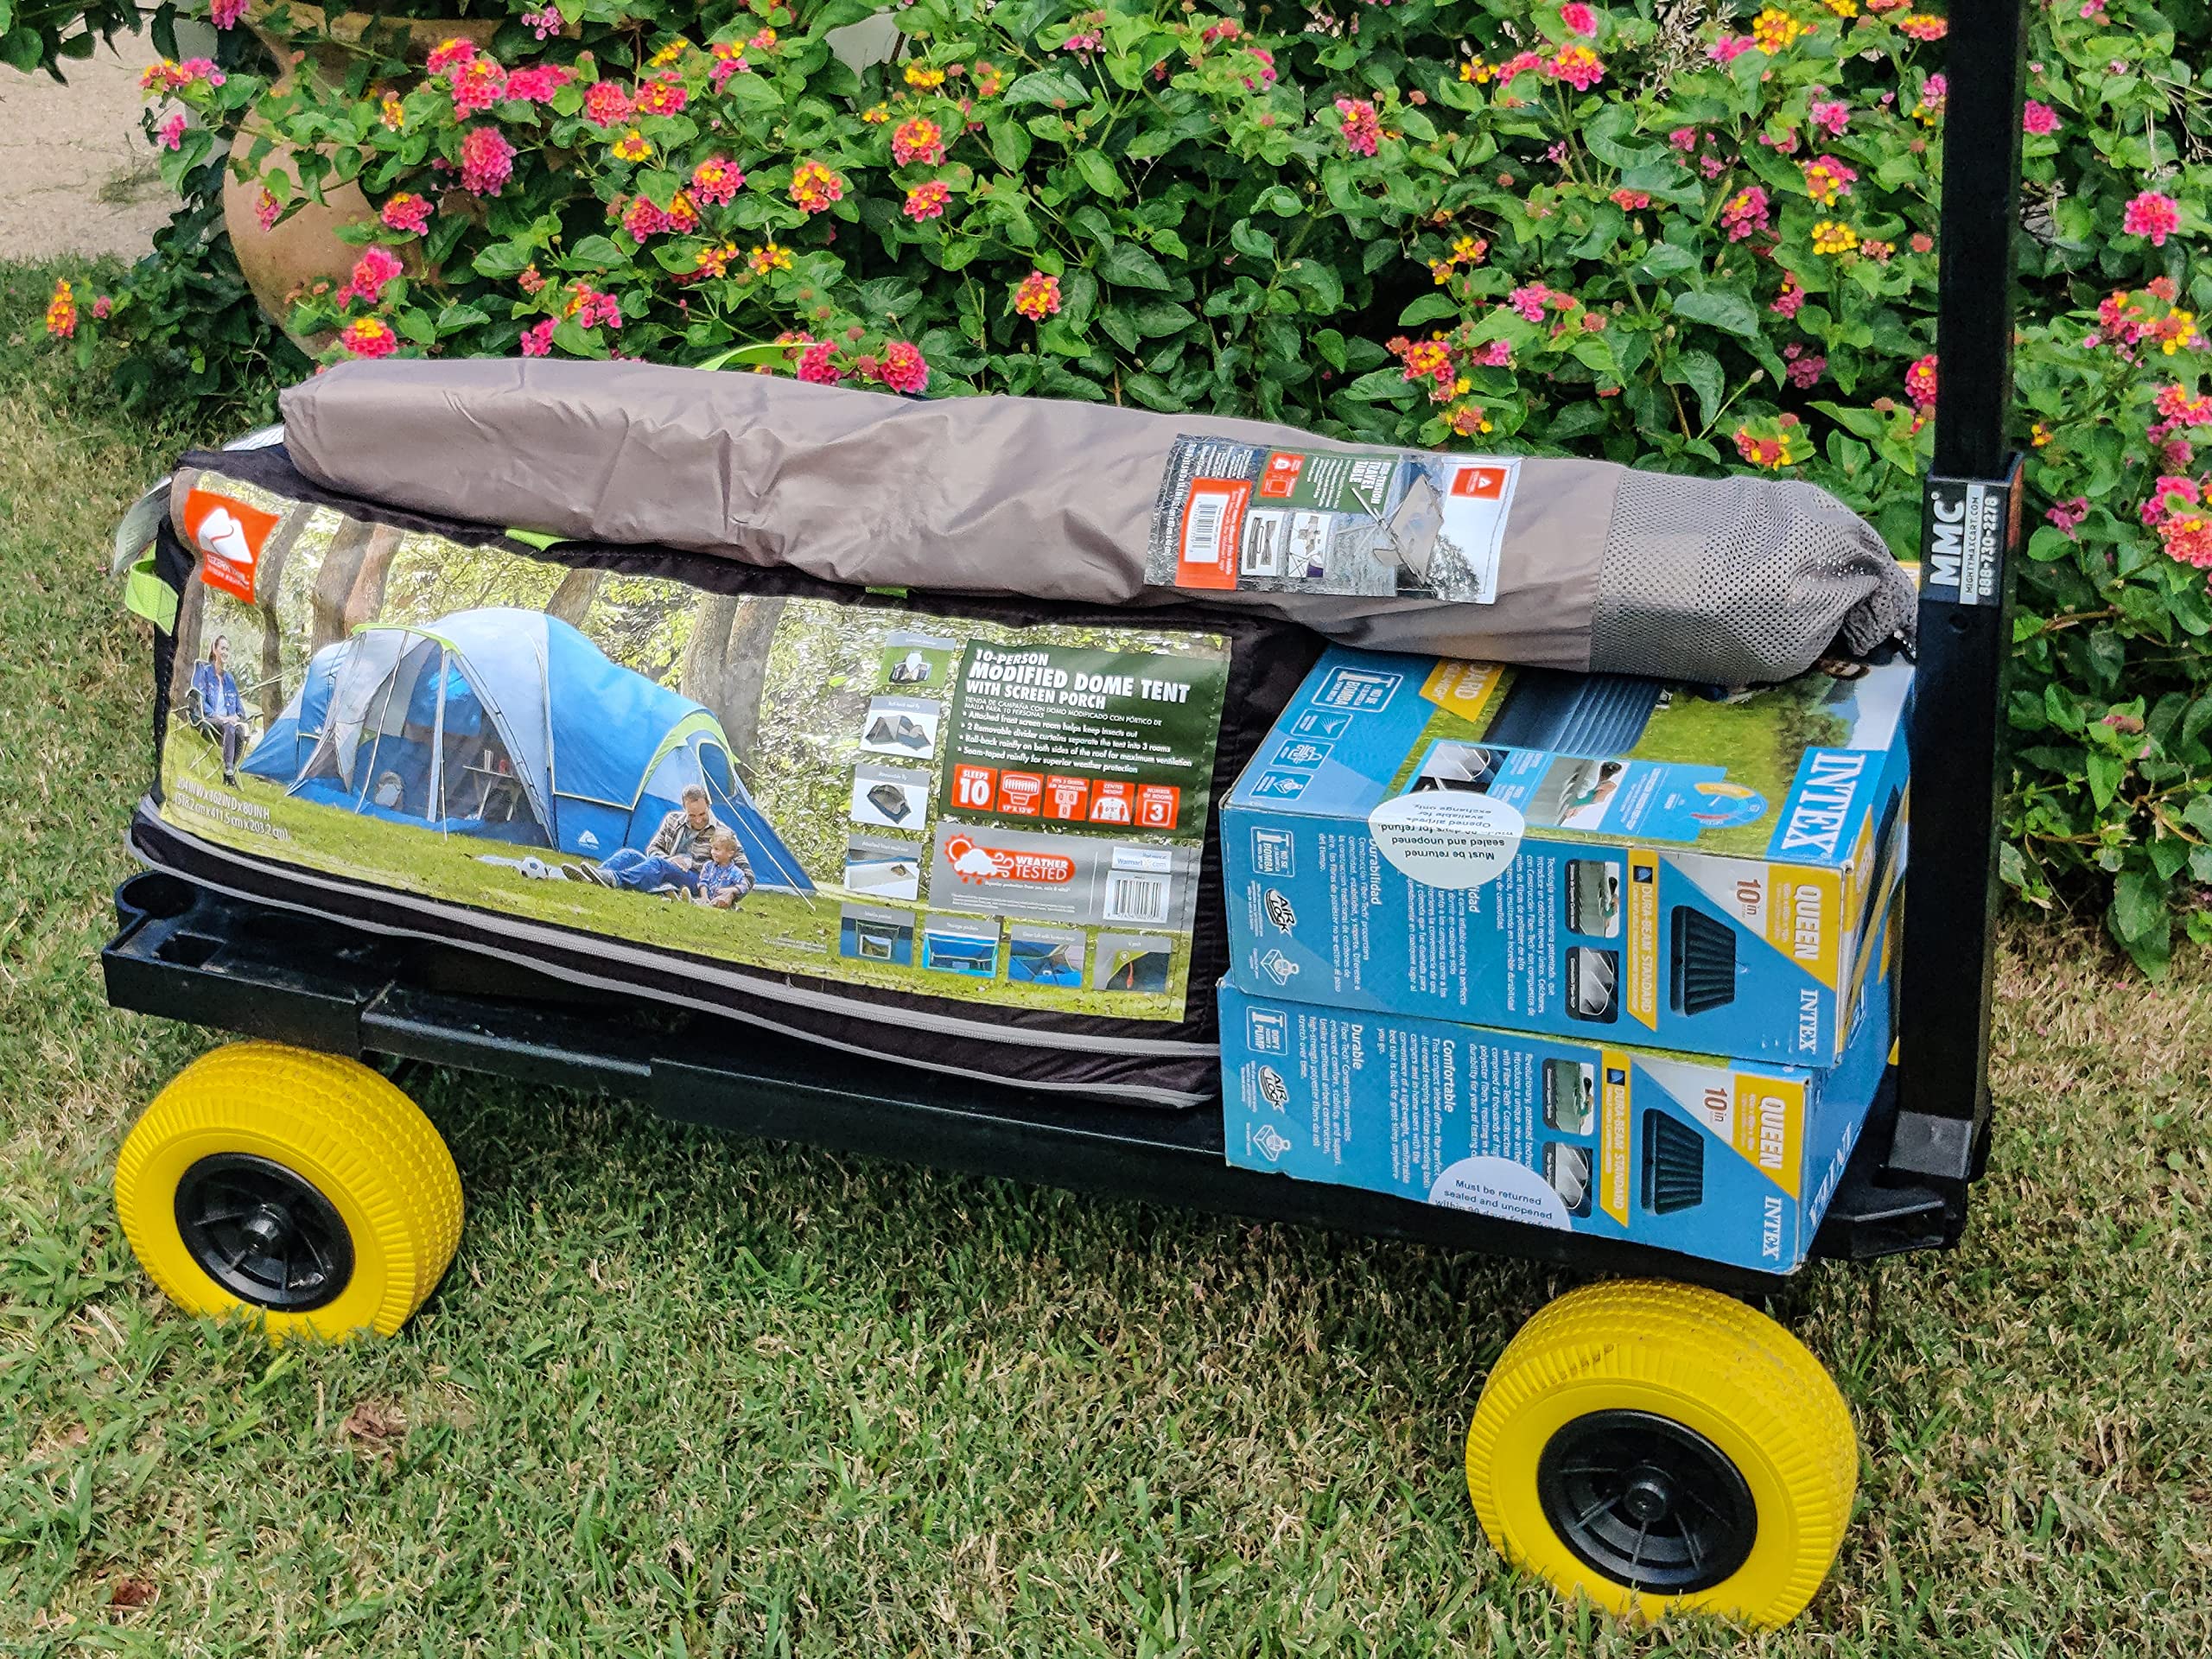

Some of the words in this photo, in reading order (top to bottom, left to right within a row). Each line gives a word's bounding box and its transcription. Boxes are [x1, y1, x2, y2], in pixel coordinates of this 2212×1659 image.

[1349, 461, 1368, 483] TABLE
[1360, 461, 1381, 490] TRAVEL
[1966, 497, 1979, 594] MIGHTYMAXCART.COM
[1978, 495, 1999, 596] 888-730-2278
[976, 649, 1049, 667] 10-PERSON
[966, 681, 1001, 696] WITH
[1003, 685, 1056, 703] SCREEN
[1059, 692, 1107, 709] PORCH
[969, 662, 1067, 689] MODIFIED
[1074, 673, 1134, 696] DOME
[1141, 680, 1191, 703] TENT
[968, 711, 1000, 722] Attached
[1001, 715, 1018, 724] front
[1061, 722, 1081, 734] helps
[1081, 724, 1100, 736] keep
[1101, 727, 1124, 736] insects
[973, 723, 1012, 735] Removable
[1013, 728, 1038, 739] divider
[1039, 732, 1066, 742] curtains
[1067, 735, 1098, 747] separate
[1099, 738, 1111, 747] the
[1111, 740, 1126, 748] tent
[1127, 741, 1141, 750] into
[1148, 744, 1171, 753] rooms
[998, 739, 1021, 751] rainfly
[1033, 742, 1050, 752] both
[1051, 745, 1069, 754] sides
[1070, 747, 1078, 755] of
[1079, 747, 1090, 756] the
[1091, 749, 1107, 758] roof
[1120, 752, 1154, 763] maximum
[1155, 755, 1192, 767] ventilation
[1006, 751, 1029, 764] rainfly
[1042, 755, 1071, 768] superior
[1072, 759, 1102, 770] weather
[1102, 762, 1138, 775] protection
[962, 770, 988, 780] SLEEPS
[957, 778, 991, 806] 10
[1781, 751, 1867, 855] INTEX
[1147, 803, 1166, 822] 3
[1378, 823, 1415, 832] refund.
[1392, 836, 1444, 845] unopened
[1014, 855, 1068, 869] WEATHER
[1262, 842, 1273, 872] BOMBA
[1469, 852, 1494, 861] Must
[1014, 865, 1068, 881] TESTED
[1736, 877, 1760, 904] 10
[1270, 899, 1287, 931] LOCK
[1278, 895, 1294, 924] AIR
[1746, 904, 1761, 915] in
[1791, 883, 1821, 960] QUEEN
[1641, 954, 1652, 1013] STANDARD
[1254, 1023, 1264, 1049] PUMP
[1798, 988, 1818, 1055] INTEX
[1351, 1023, 1363, 1070] Durable
[1399, 1031, 1408, 1077] convenience
[1409, 1033, 1418, 1064] campers
[1401, 1077, 1408, 1086] of
[1431, 1053, 1440, 1084] compact
[1443, 1039, 1455, 1113] Comfortable
[1266, 1077, 1281, 1109] LOCK
[1271, 1072, 1287, 1100] AIR
[1421, 1073, 1429, 1103] sleeping
[1703, 1085, 1727, 1112] 10
[1389, 1101, 1397, 1121] great
[1713, 1111, 1726, 1123] in
[1757, 1095, 1785, 1170] QUEEN
[1390, 1143, 1399, 1179] anywhere
[1421, 1135, 1430, 1170] providing
[1456, 1179, 1479, 1192] Must
[1484, 1185, 1495, 1195] be
[1498, 1191, 1541, 1205] returned
[1612, 1153, 1624, 1210] STANDARD
[1444, 1190, 1476, 1203] sealed
[1480, 1198, 1498, 1208] and
[1501, 1204, 1553, 1220] unopened
[1762, 1195, 1782, 1261] INTEX
